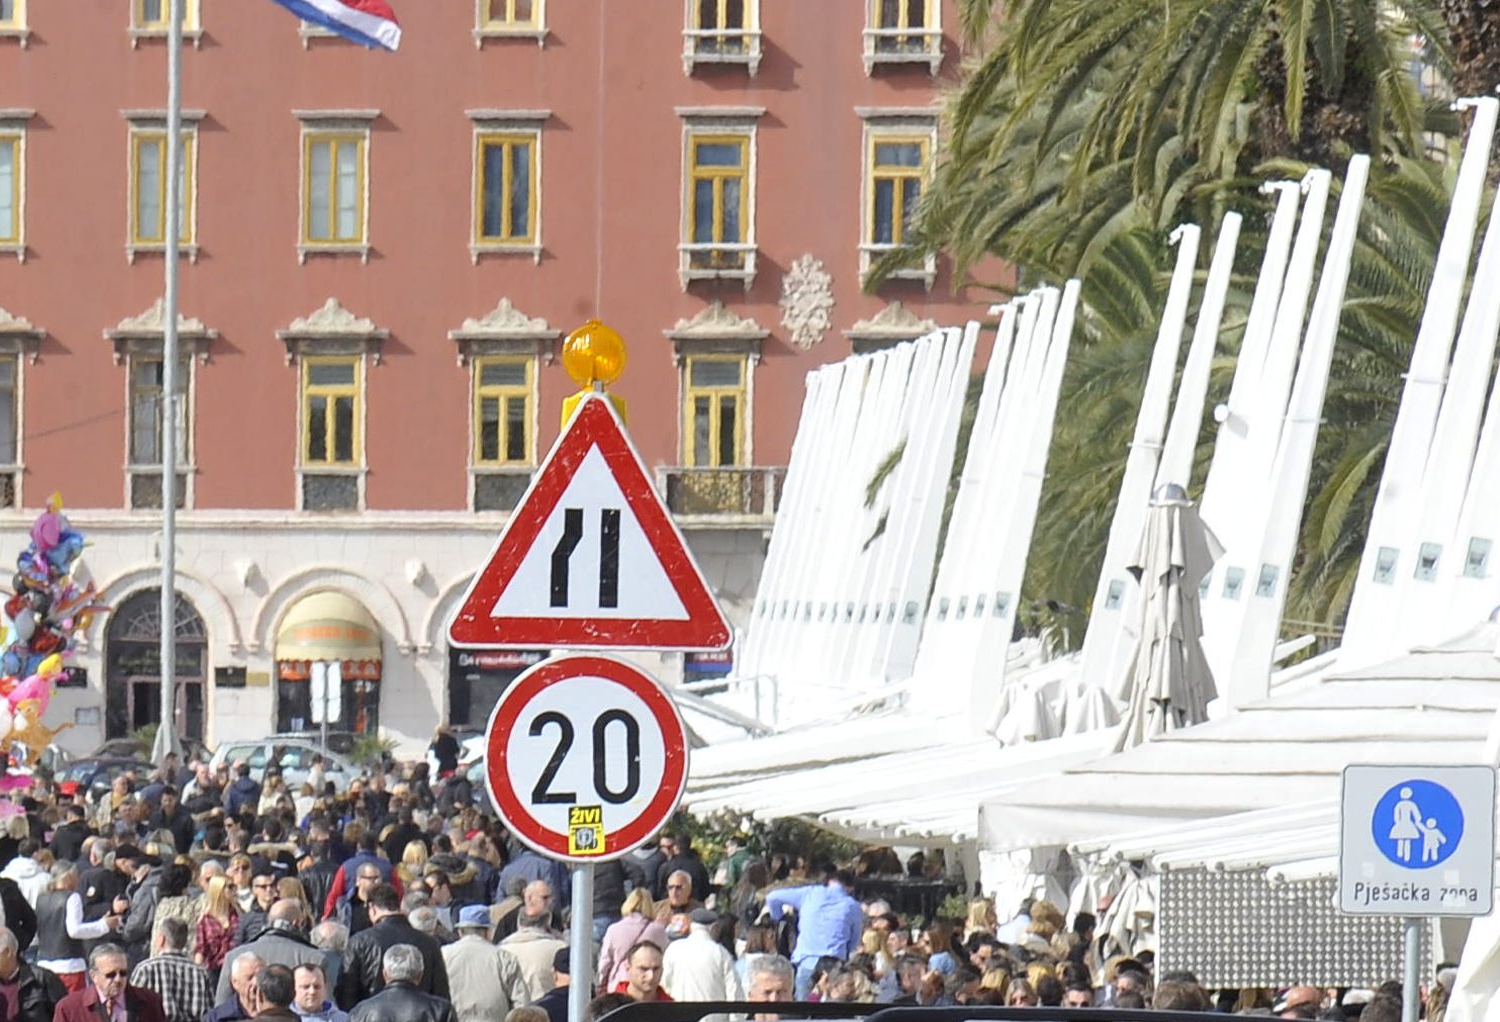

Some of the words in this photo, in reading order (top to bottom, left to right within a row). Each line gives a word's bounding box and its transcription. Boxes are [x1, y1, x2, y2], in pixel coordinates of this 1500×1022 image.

[529, 708, 640, 805] 20
[570, 807, 600, 824] ŽIVI
[1354, 881, 1430, 906] Pješačka
